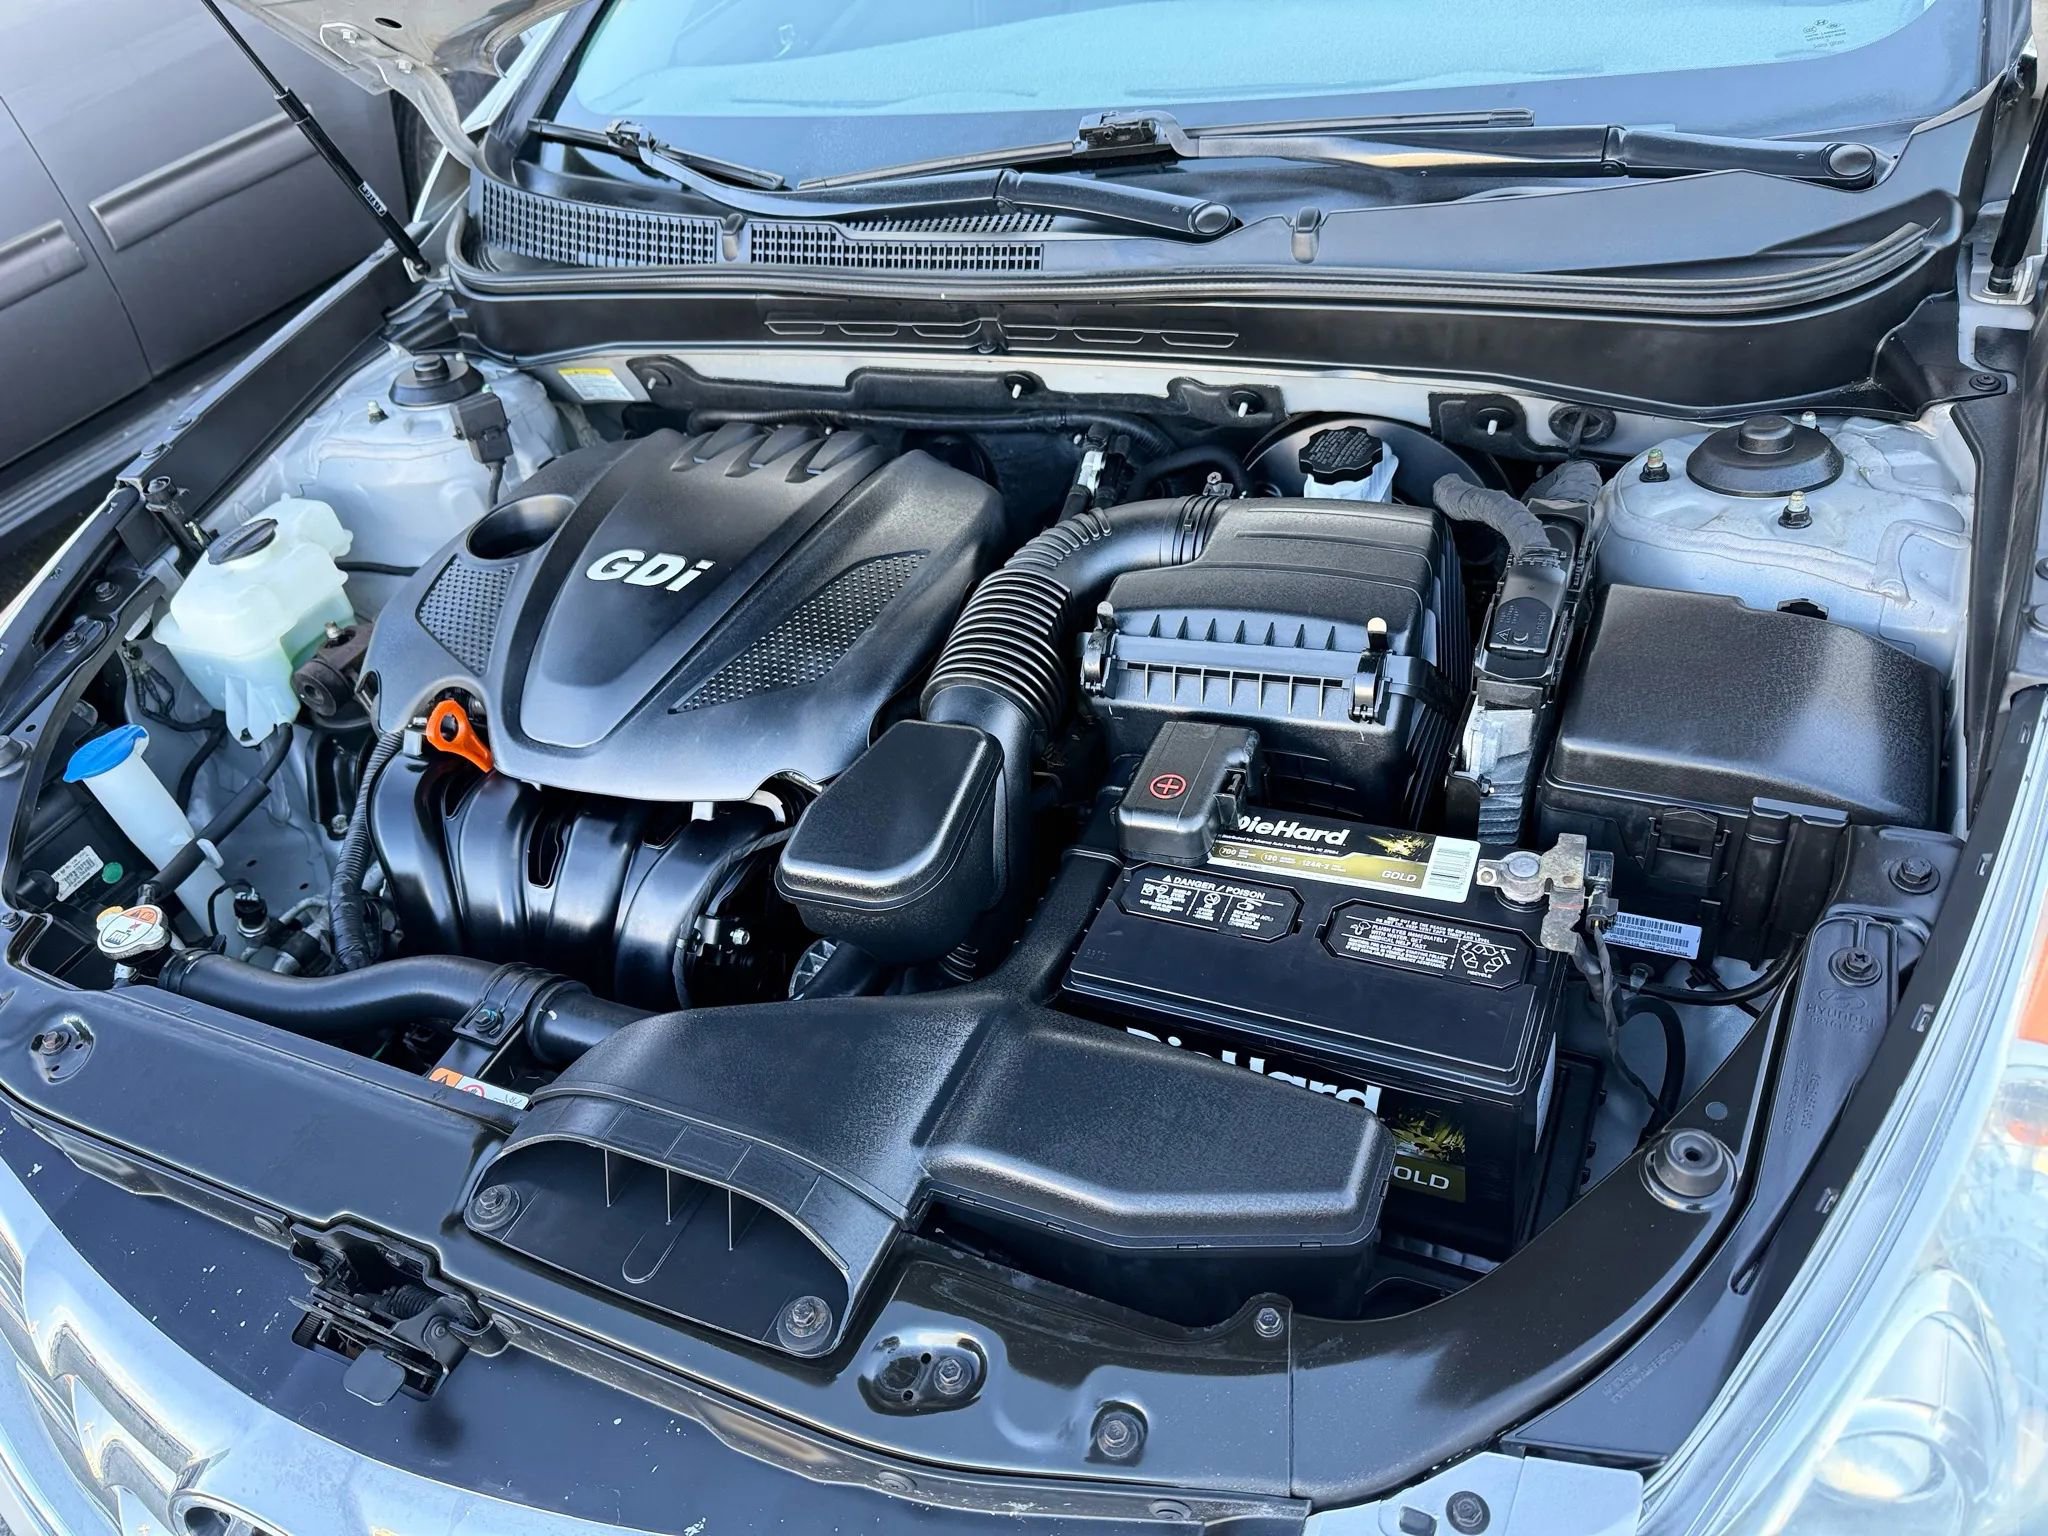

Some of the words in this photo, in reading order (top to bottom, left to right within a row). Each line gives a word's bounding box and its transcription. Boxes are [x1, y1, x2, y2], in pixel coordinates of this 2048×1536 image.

[585, 549, 717, 592] GDi
[1221, 847, 1237, 855] 700
[1264, 854, 1278, 862] 120
[1381, 870, 1418, 882] GOLD
[1173, 876, 1217, 891] DANGER
[1226, 886, 1266, 900] POISON
[1369, 934, 1394, 944] MEDICAL
[1395, 939, 1411, 947] HELP
[1411, 942, 1427, 950] FAST
[1371, 924, 1391, 933] FLUSH
[1407, 931, 1448, 944] IMMEDIATELY
[1393, 1166, 1450, 1190] OLD
